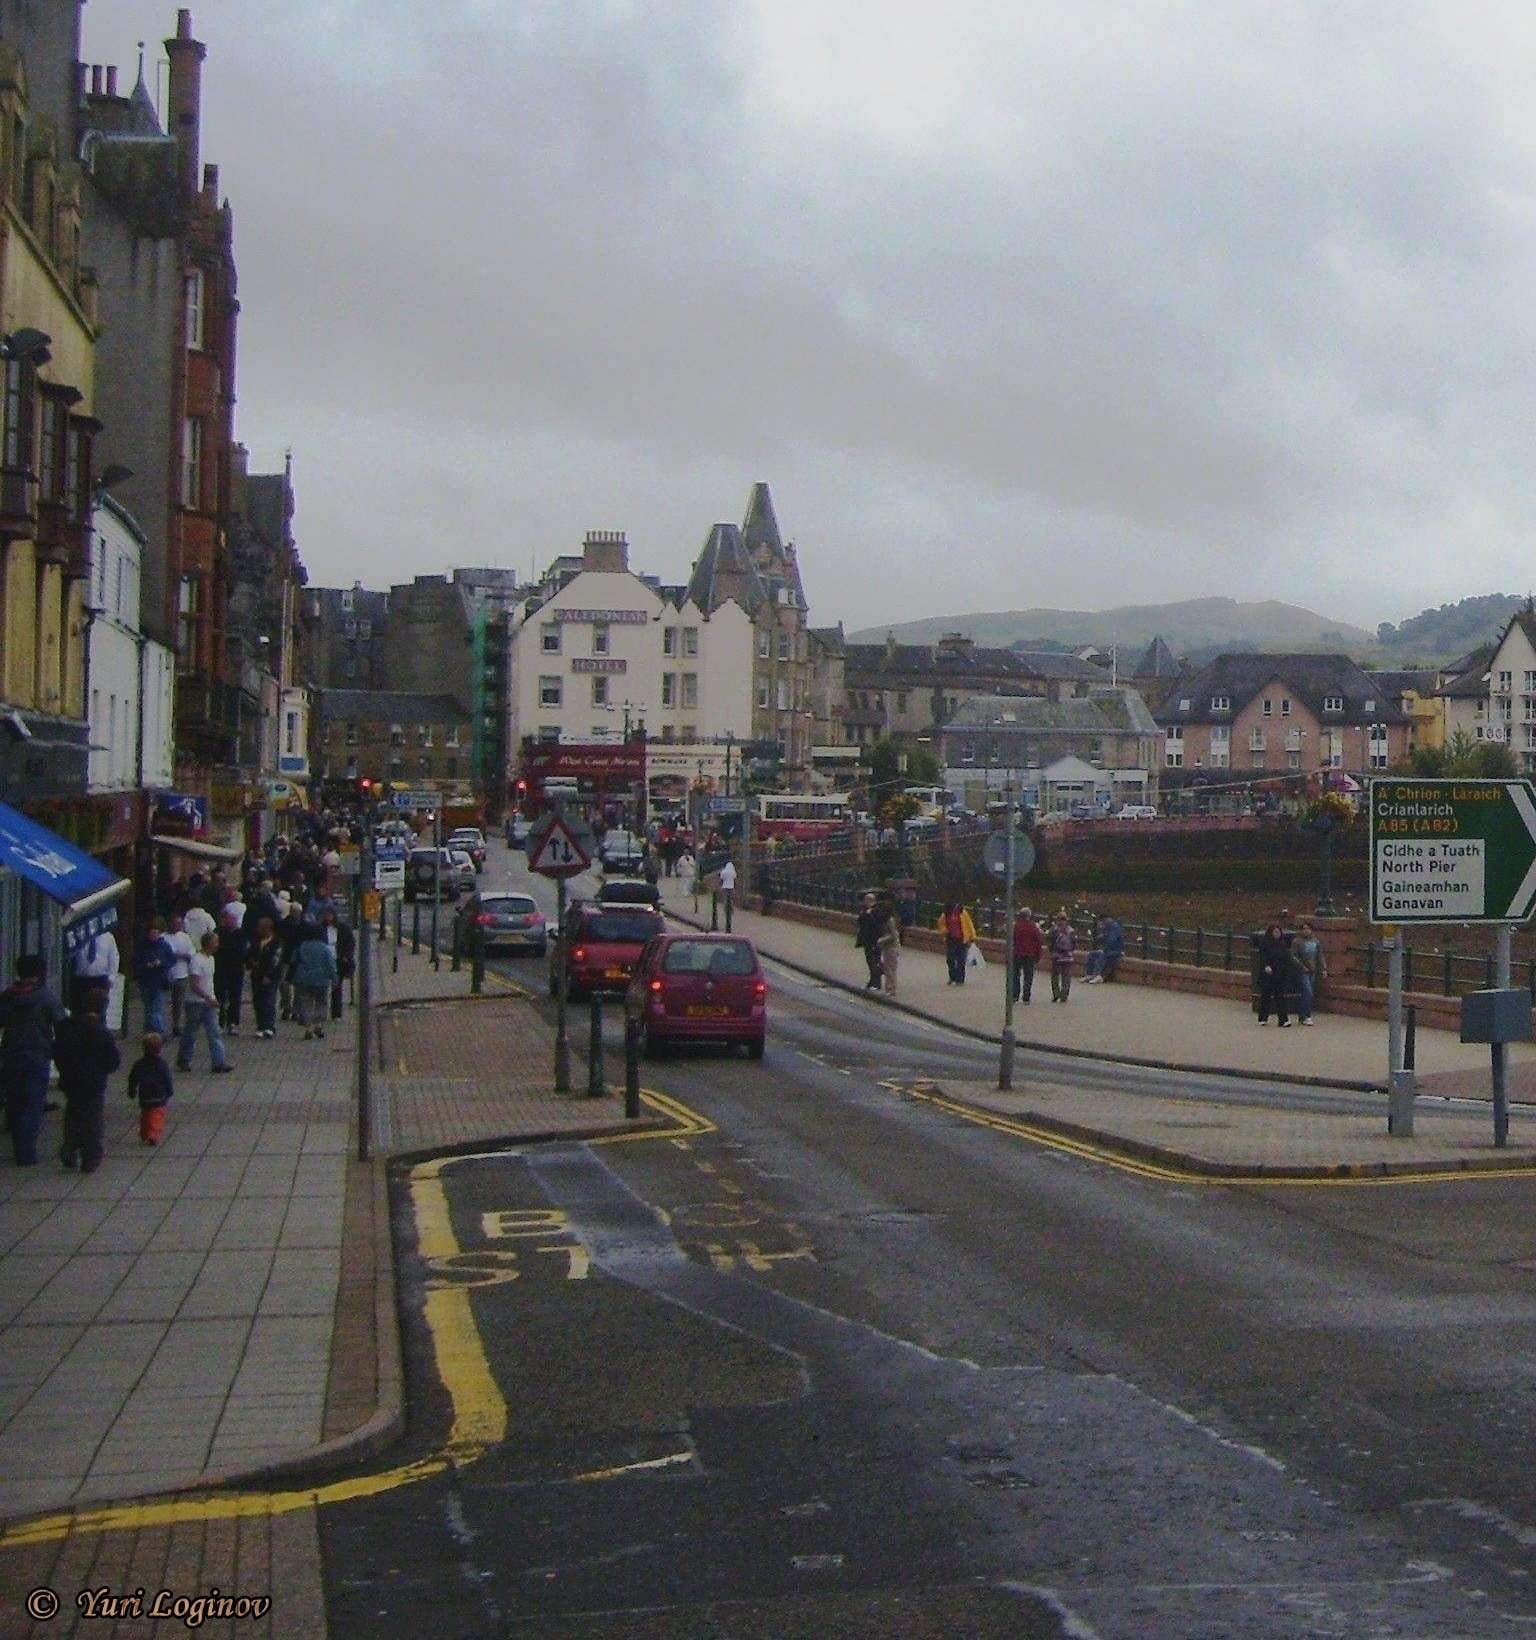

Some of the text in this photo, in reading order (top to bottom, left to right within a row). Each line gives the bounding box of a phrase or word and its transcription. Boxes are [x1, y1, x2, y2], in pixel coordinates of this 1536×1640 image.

[1378, 803, 1453, 816] Crianlarich
[1378, 819, 1408, 832] A85
[1383, 844, 1480, 857] Cidhe a Tuath
[1383, 860, 1456, 873] North Pier
[1383, 880, 1469, 893] Gaineamhan
[1383, 897, 1443, 909] Ganavan
